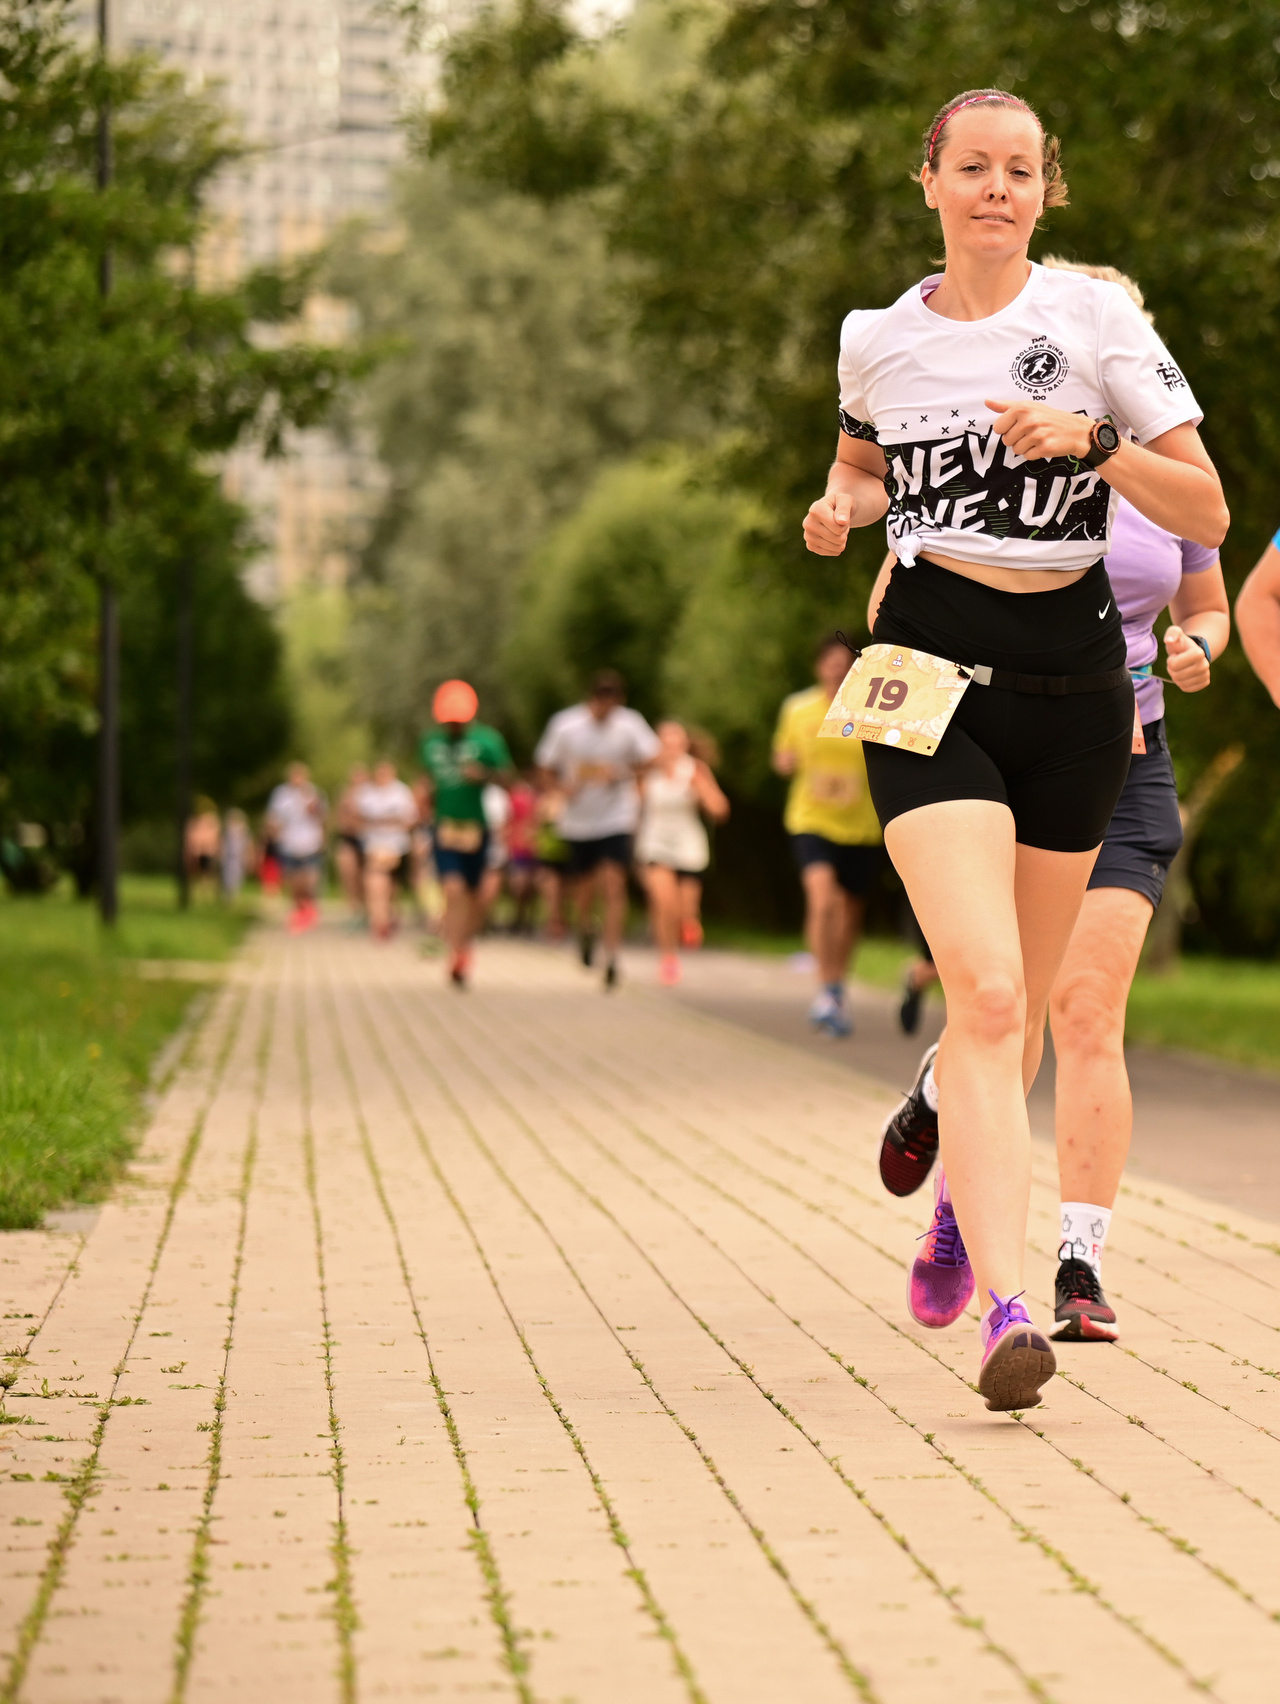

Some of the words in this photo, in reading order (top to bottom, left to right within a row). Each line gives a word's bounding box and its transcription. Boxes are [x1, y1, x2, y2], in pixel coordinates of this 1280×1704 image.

[1015, 344, 1045, 361] GOLDEN
[1047, 344, 1064, 357] RING
[1015, 380, 1039, 394] ULTRA
[1042, 378, 1065, 393] TRAIL
[1018, 471, 1101, 529] UP
[864, 676, 909, 712] 19
